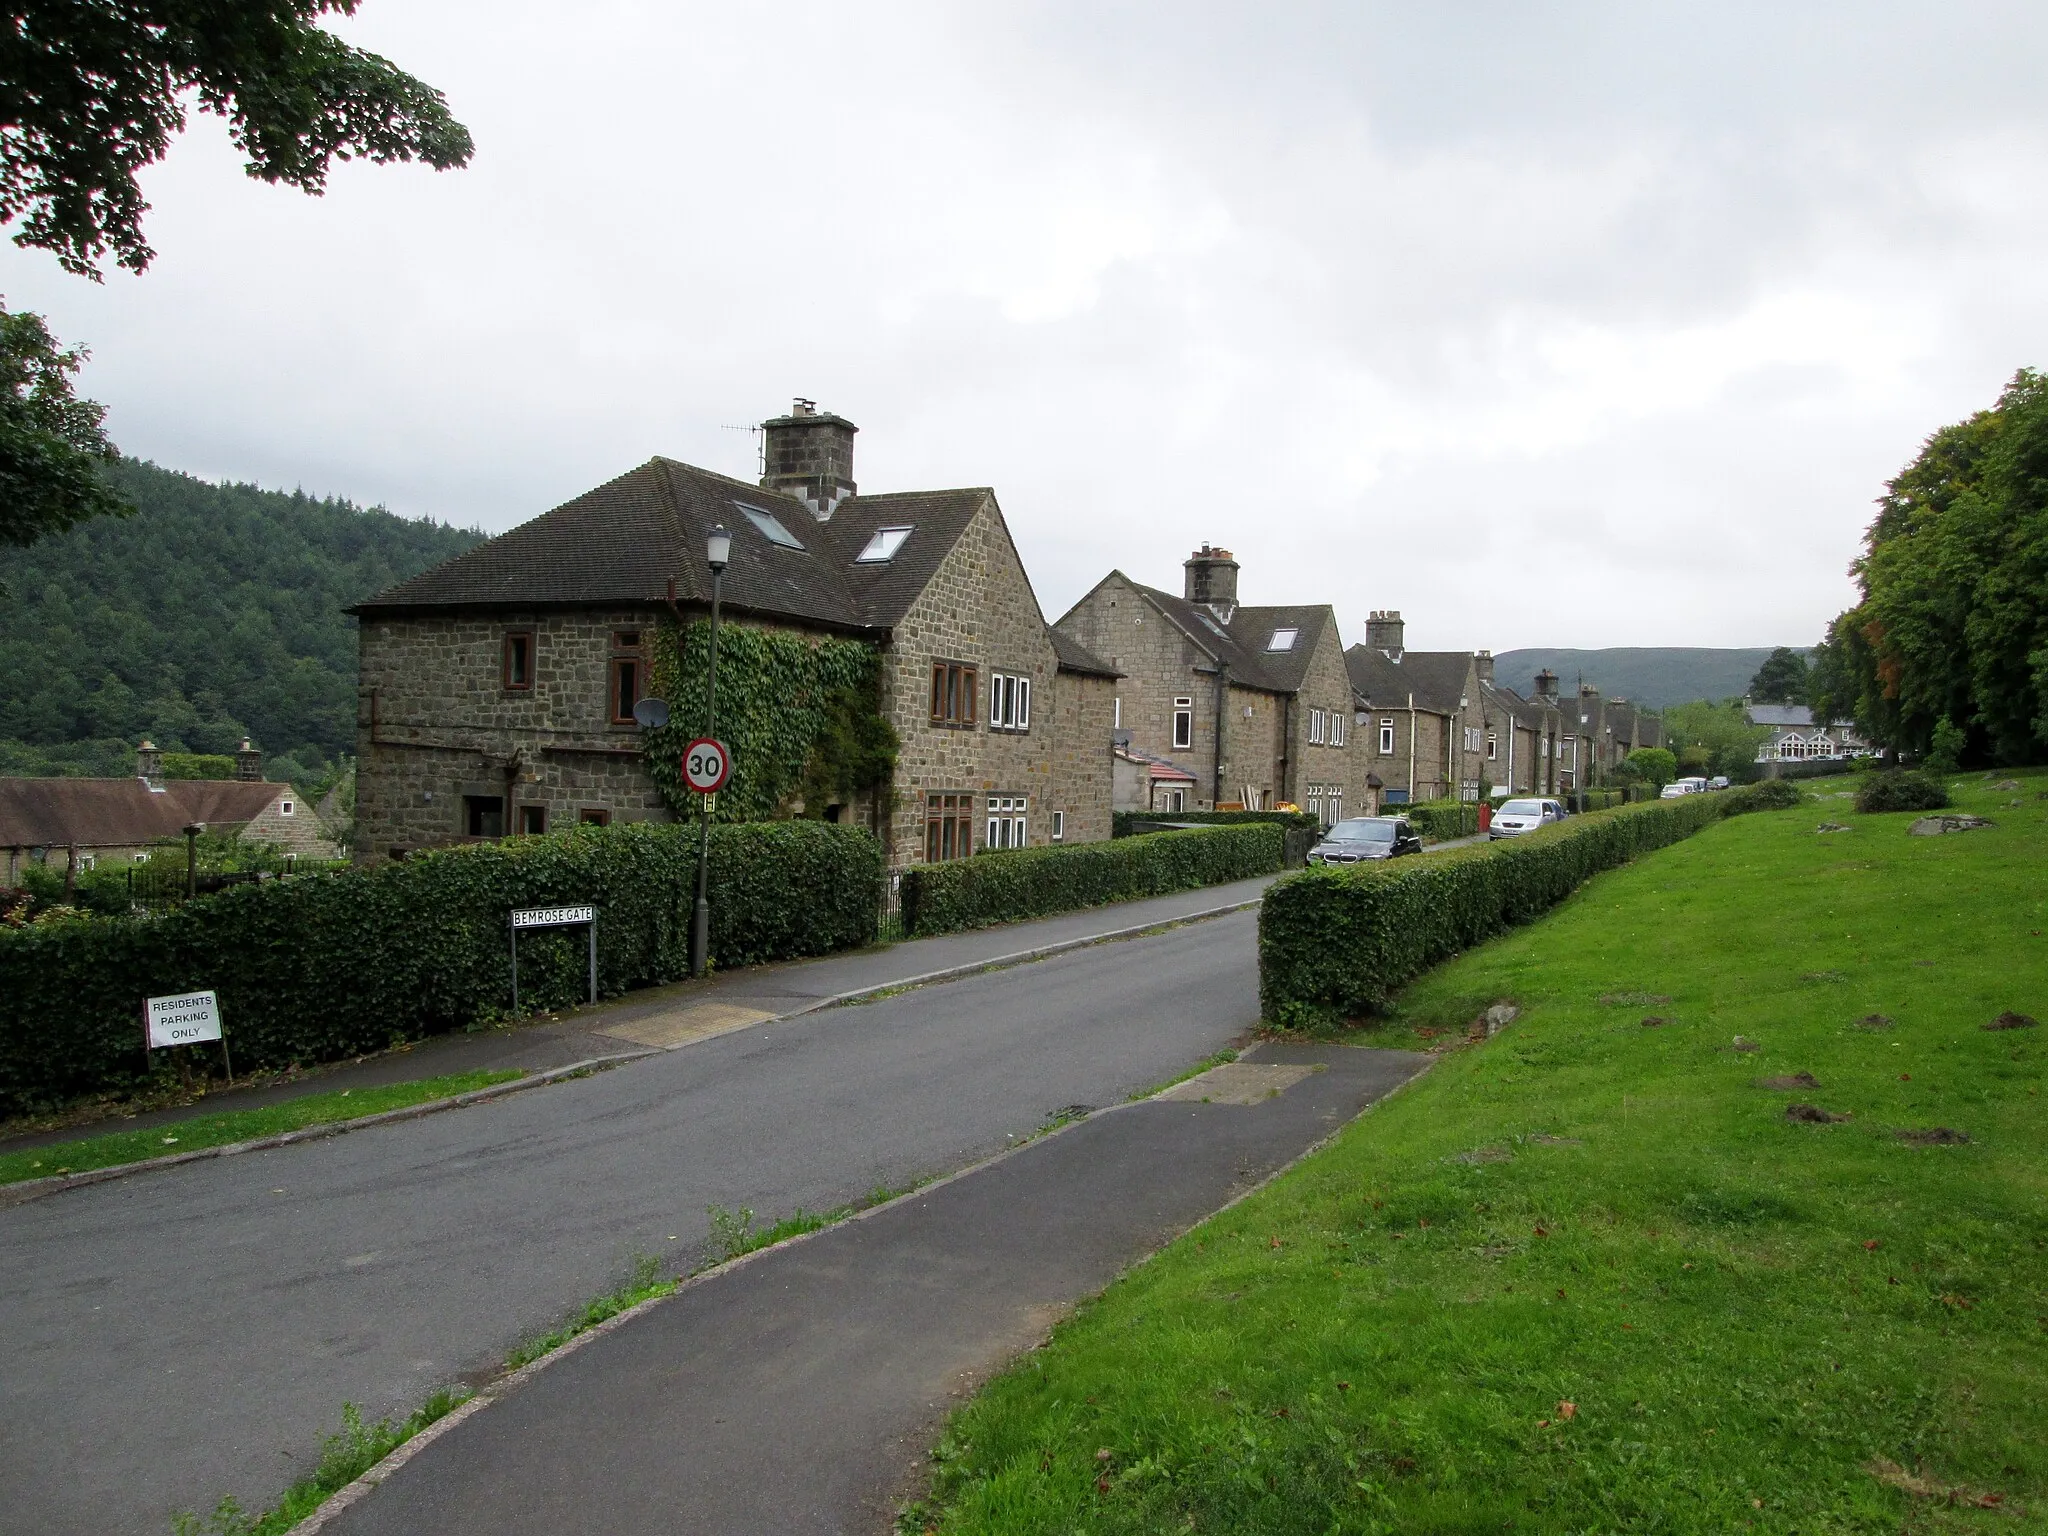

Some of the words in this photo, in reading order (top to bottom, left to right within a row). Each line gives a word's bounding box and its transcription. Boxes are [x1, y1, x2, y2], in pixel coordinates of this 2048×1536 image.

[689, 754, 720, 777] 30
[514, 909, 564, 925] BEMROSE
[566, 907, 591, 921] GATE
[153, 996, 212, 1012] RESIDENTS
[161, 1011, 208, 1026] PARKING
[171, 1027, 200, 1039] ONLY
